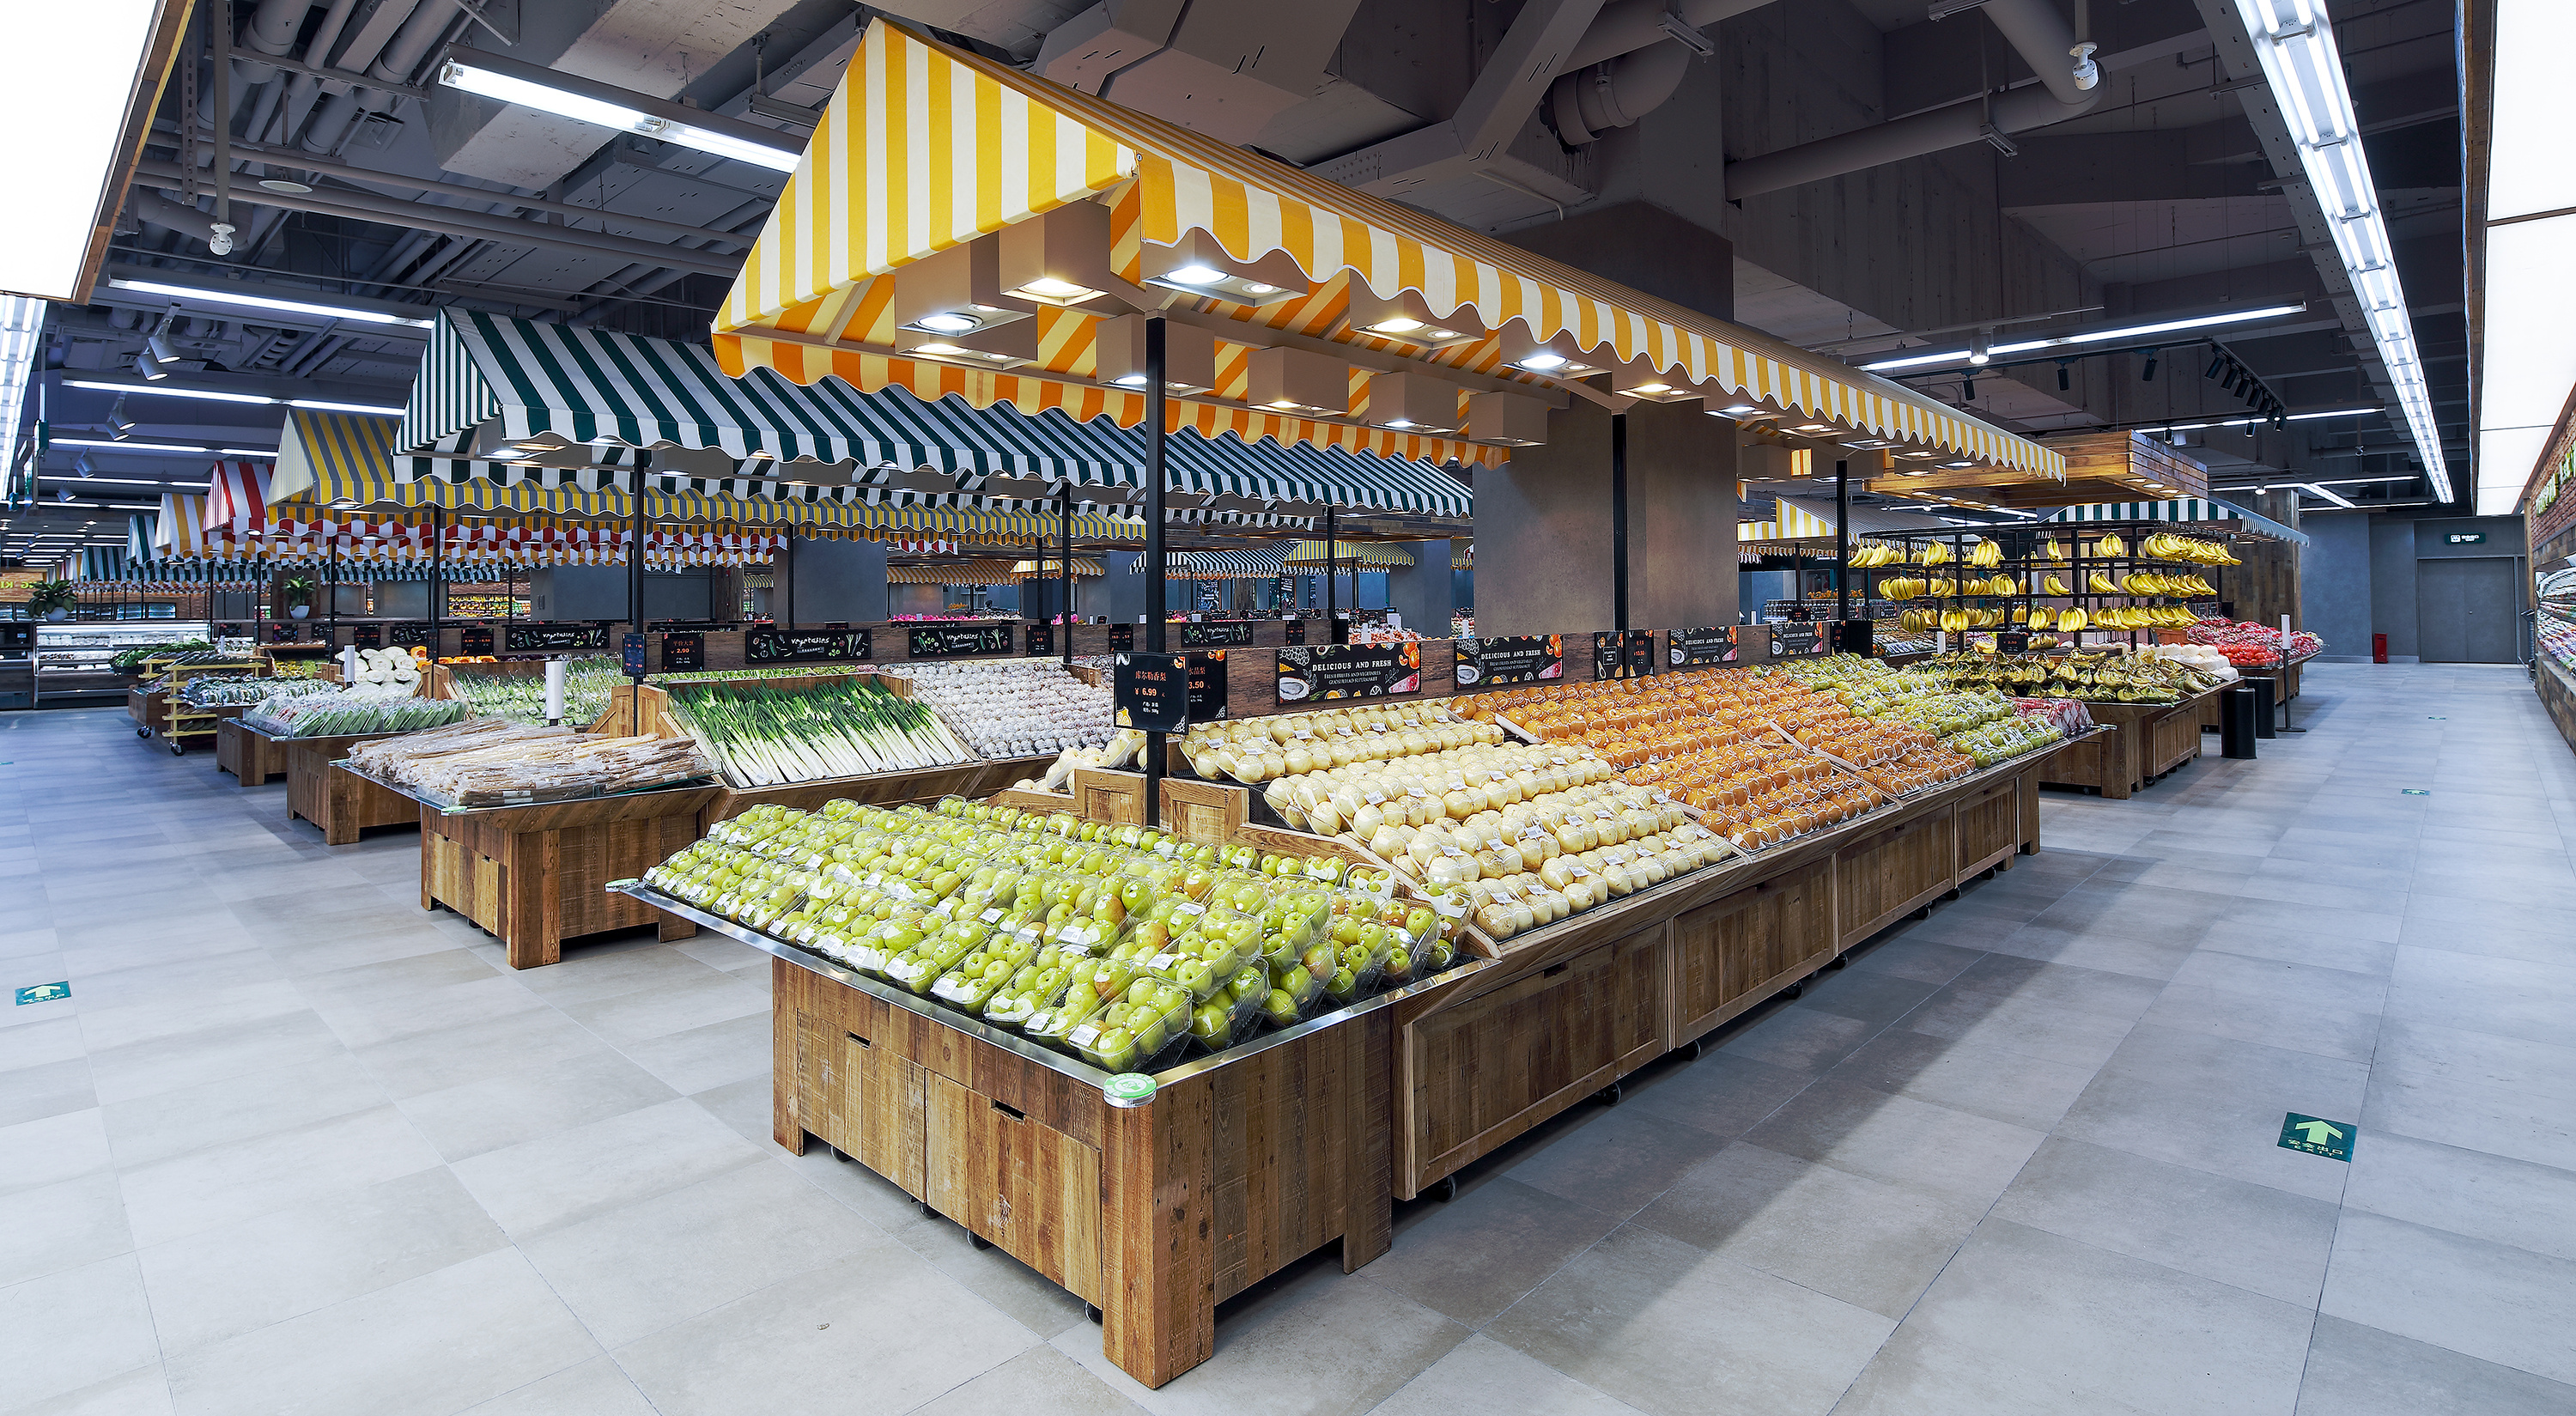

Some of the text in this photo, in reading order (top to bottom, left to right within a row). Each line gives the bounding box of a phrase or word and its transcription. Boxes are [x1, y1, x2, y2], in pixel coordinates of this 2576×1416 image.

[1480, 651, 1510, 660] DELICIOUS
[1312, 662, 1352, 672] DELICIOUS
[1371, 659, 1392, 668] FRESH
[1188, 680, 1205, 690] 3.50
[1142, 687, 1157, 696] 6.99
